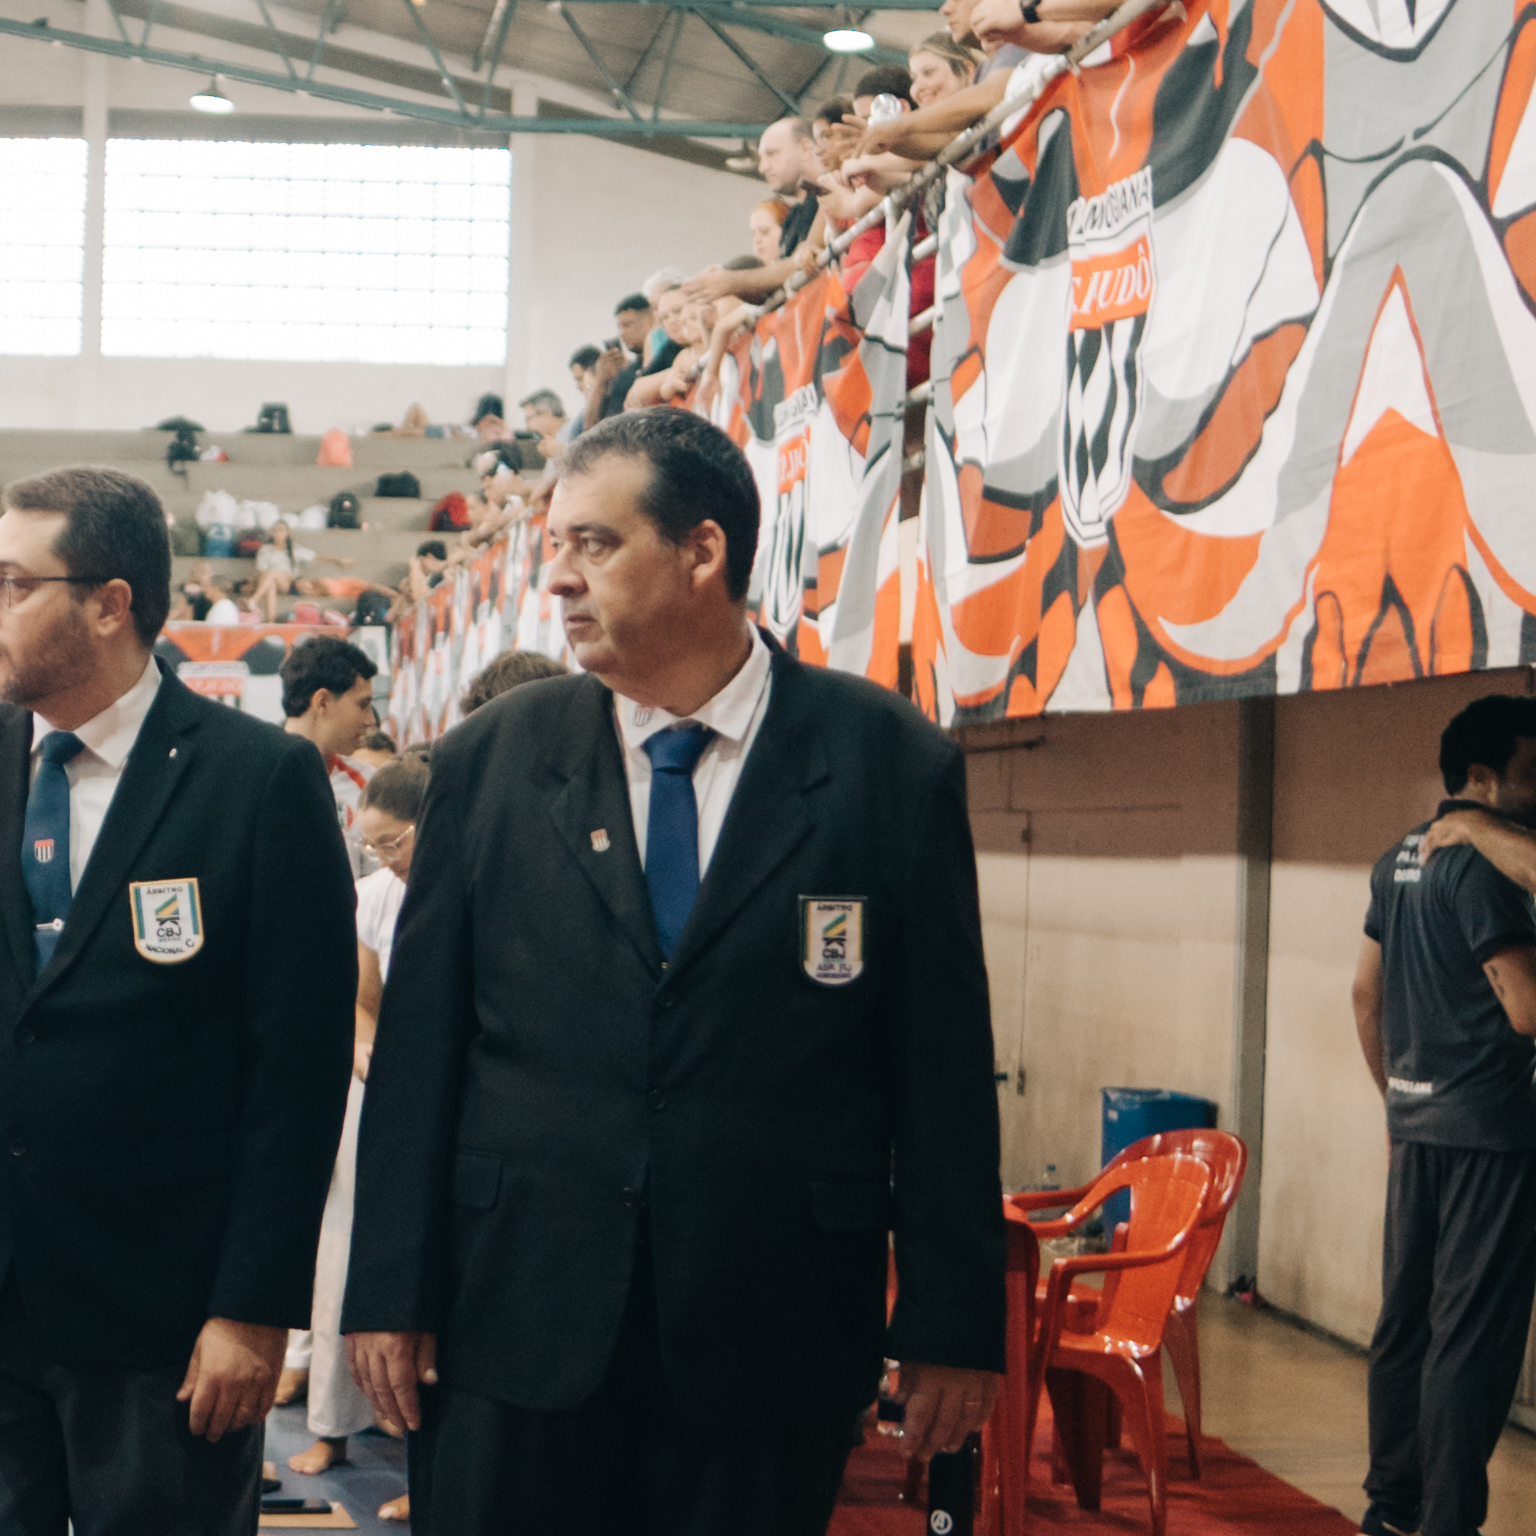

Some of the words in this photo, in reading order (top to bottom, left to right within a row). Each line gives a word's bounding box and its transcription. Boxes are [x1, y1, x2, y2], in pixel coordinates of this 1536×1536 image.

[146, 886, 184, 895] ÁRBITRO
[156, 926, 182, 938] CBJ
[145, 943, 185, 954] NACIONAL
[822, 947, 846, 959] CBJ
